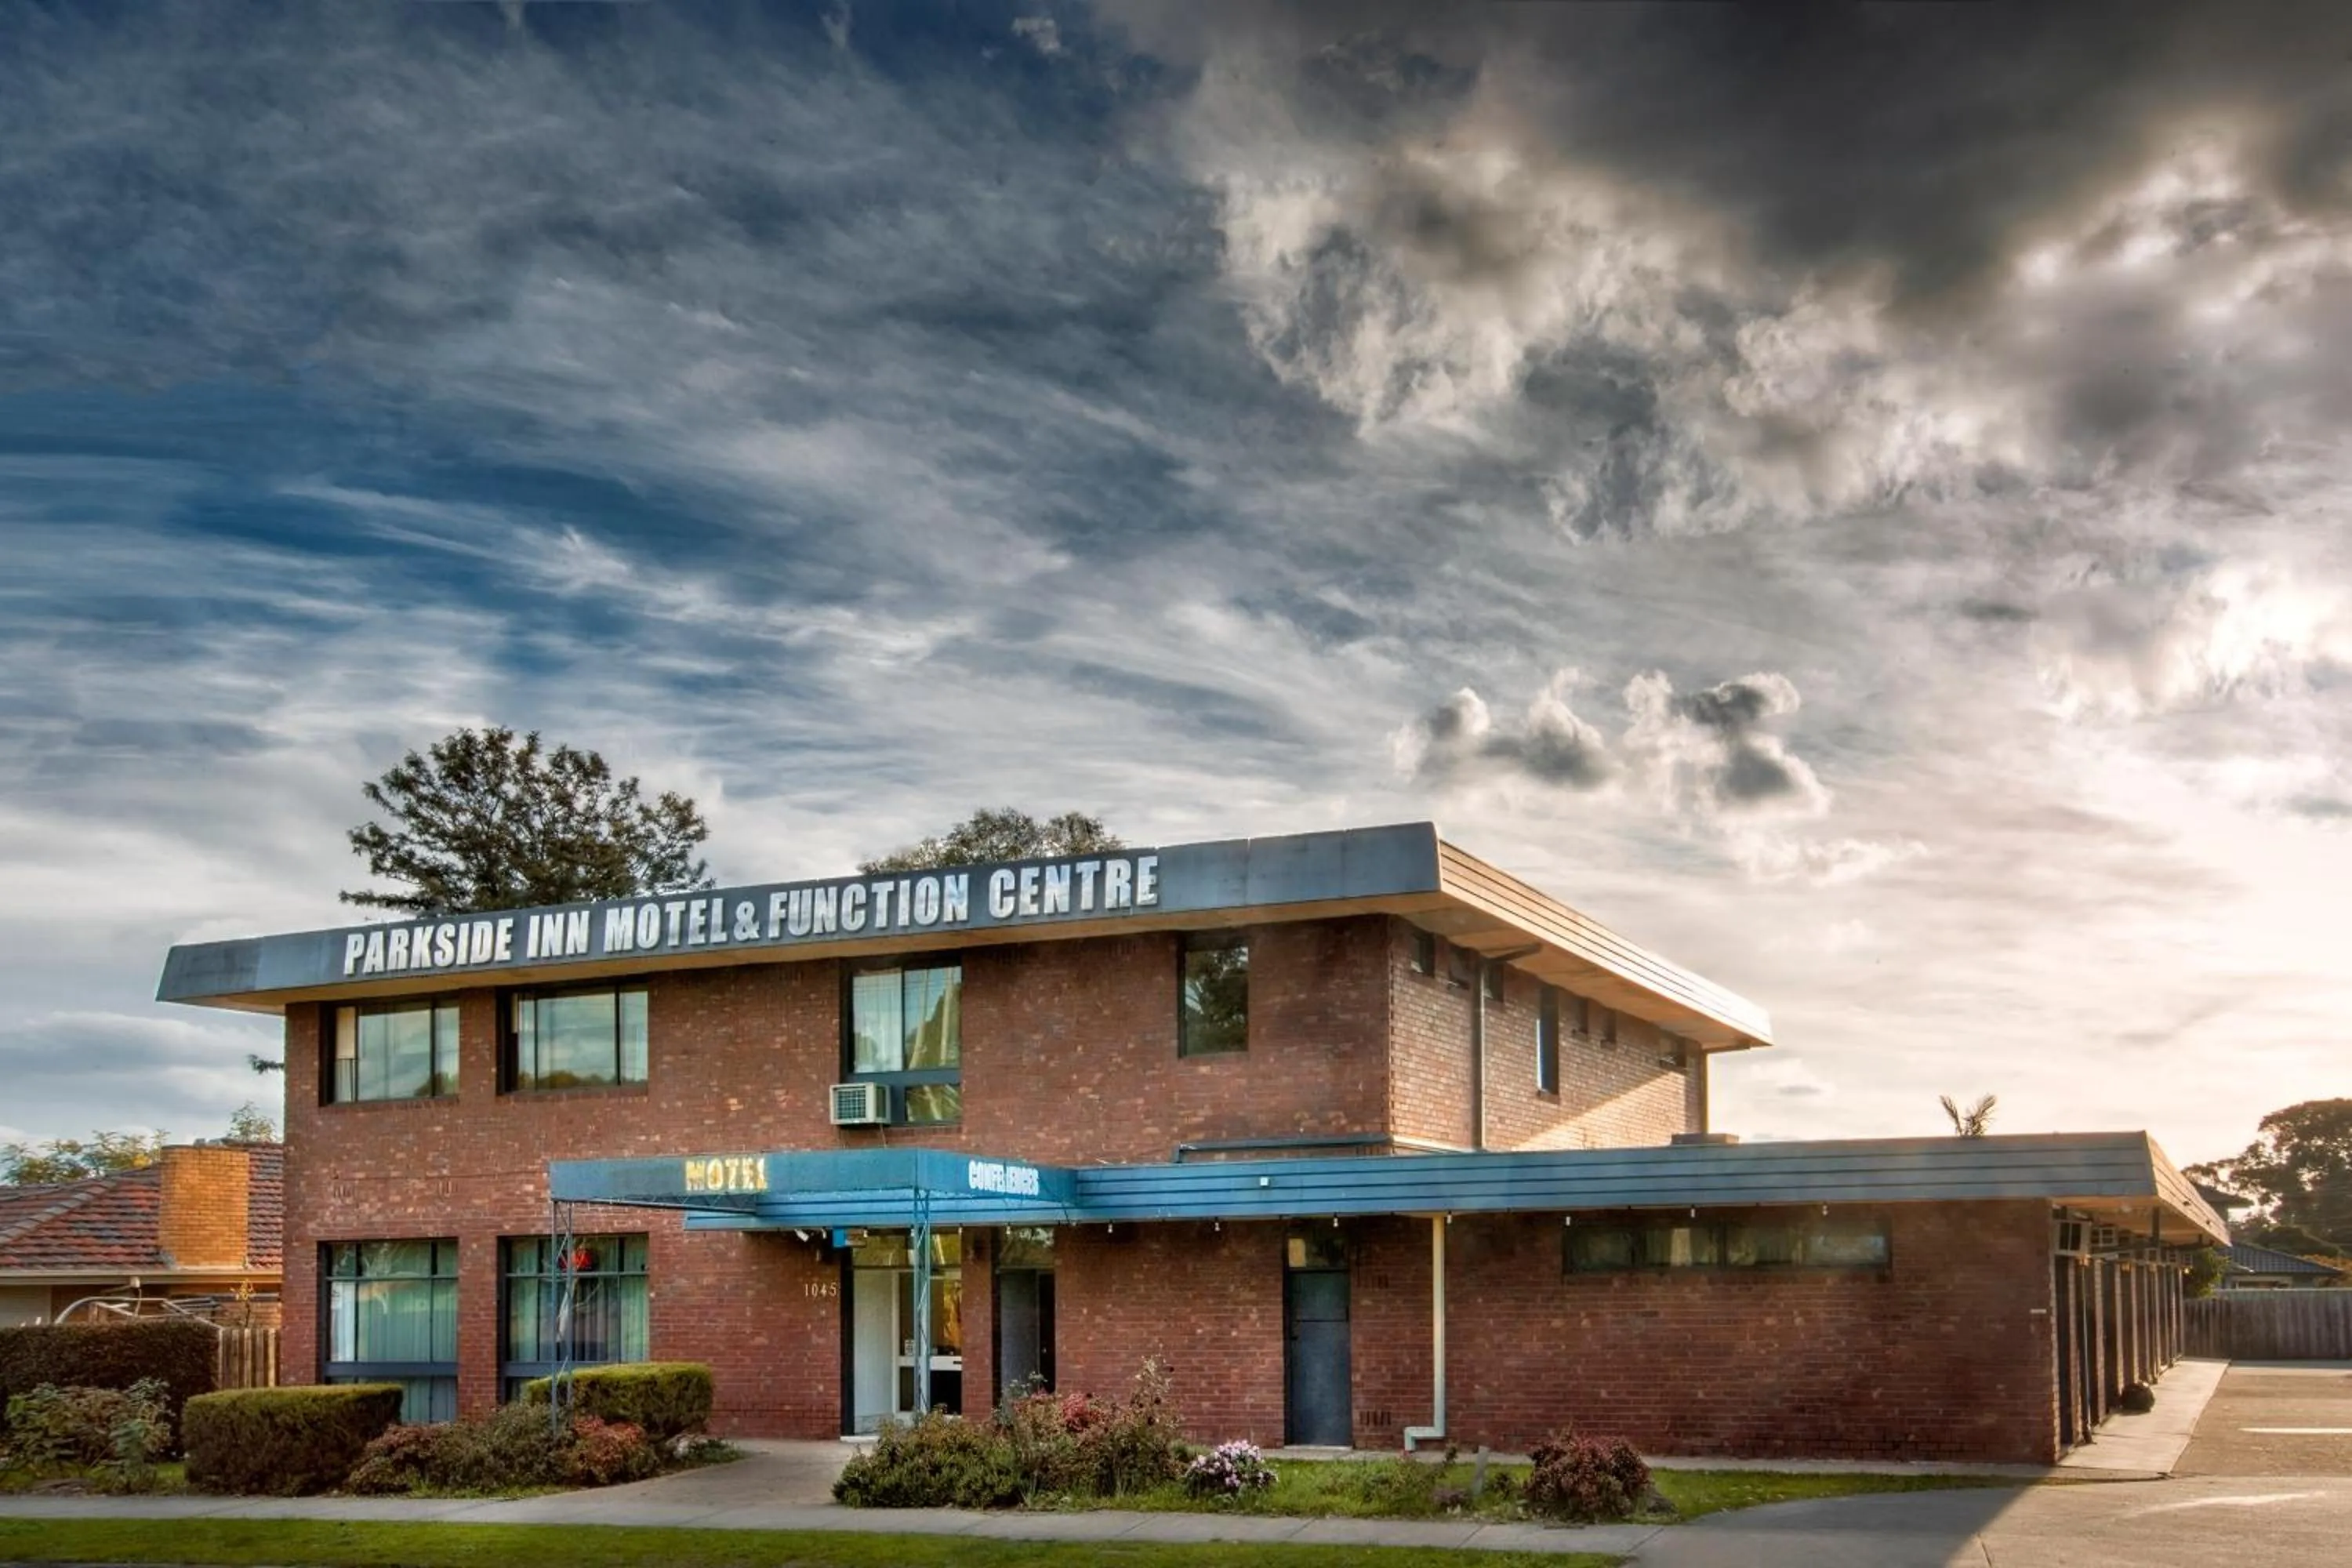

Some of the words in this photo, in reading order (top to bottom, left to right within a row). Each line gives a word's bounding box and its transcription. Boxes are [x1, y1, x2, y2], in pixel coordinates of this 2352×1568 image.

[343, 917, 514, 975] PARKSIDE
[527, 909, 590, 959] INN
[604, 898, 726, 953] MOTEL
[733, 901, 760, 941] &
[768, 872, 969, 938] FUNCTION
[989, 855, 1158, 918] CENTRE
[685, 1157, 768, 1191] MOTEL
[804, 1282, 837, 1298] 1045
